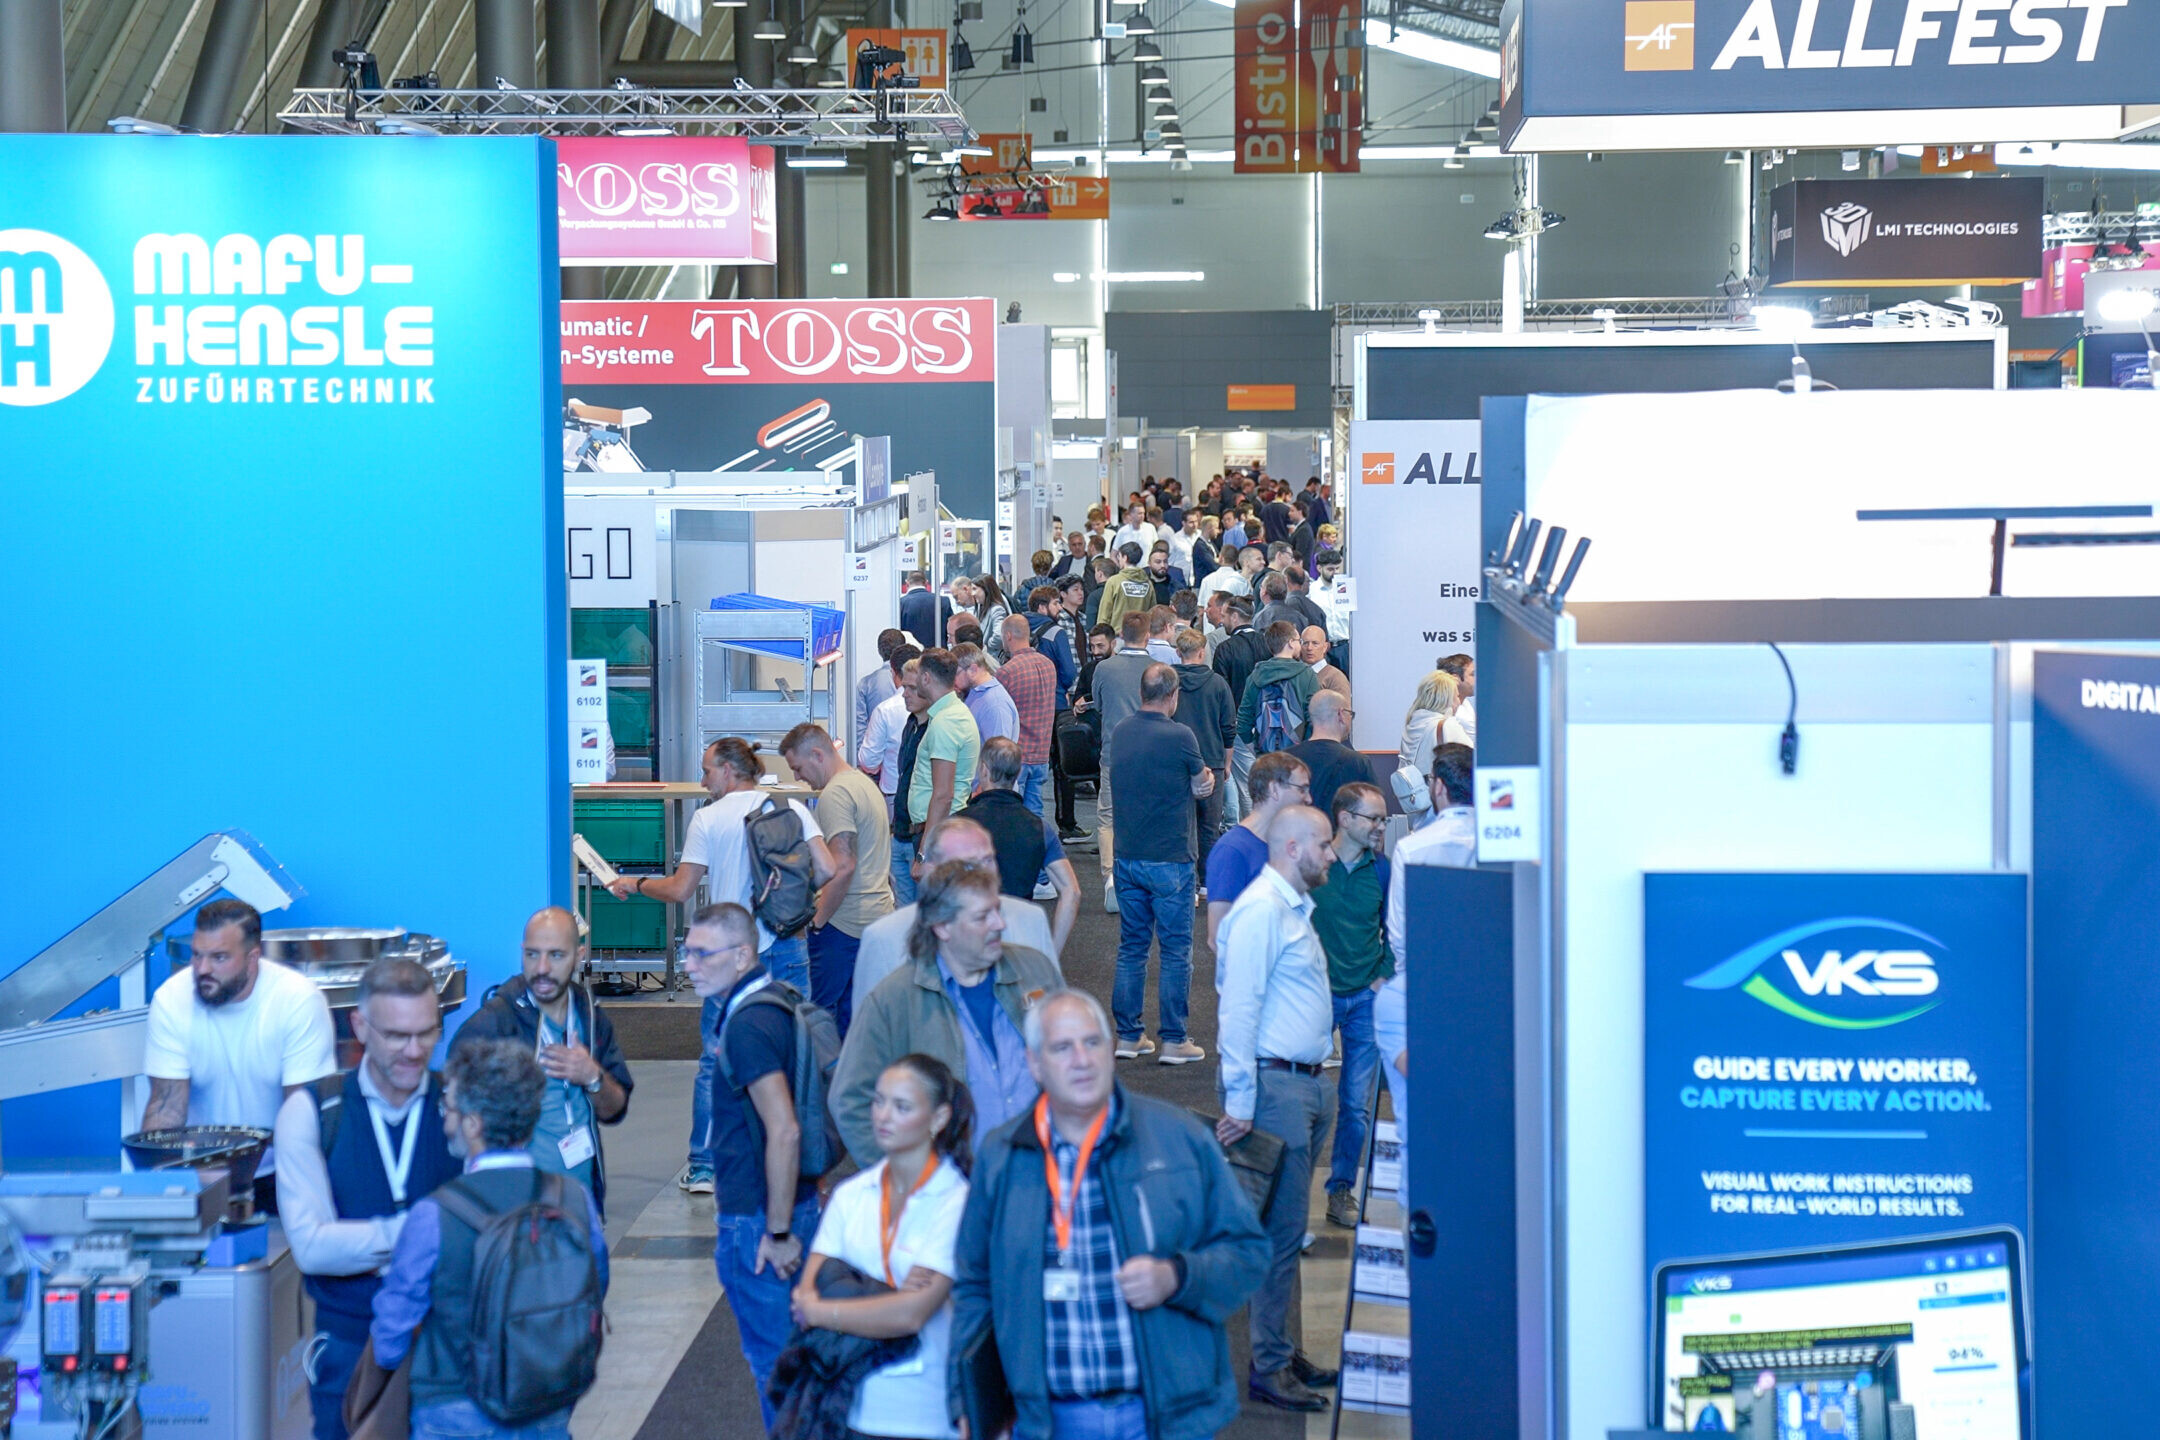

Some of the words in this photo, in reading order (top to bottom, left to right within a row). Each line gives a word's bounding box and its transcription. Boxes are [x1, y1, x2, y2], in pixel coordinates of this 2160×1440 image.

[1710, 0, 2128, 70] ALLFEST
[1244, 12, 1286, 165] Bistro
[687, 219, 695, 229] &
[1824, 202, 1869, 222] 3D
[1820, 211, 1873, 257] LMI
[1876, 224, 1901, 237] LMI
[1904, 223, 2019, 237] TECHNOLOGIES
[134, 304, 434, 366] HENSLE
[690, 307, 973, 376] TOSS
[136, 372, 436, 404] ZUFÜHRTECHNIK
[1440, 583, 1479, 598] Eine
[1423, 630, 1458, 642] was
[577, 697, 602, 707] 6102
[576, 759, 601, 768] 6101
[1484, 826, 1521, 839] 6204
[1781, 949, 1940, 996] VKS
[1693, 1056, 1771, 1081] GUIDE
[1774, 1057, 1855, 1082] EVERY
[1857, 1057, 1978, 1086] WORKER,
[1680, 1085, 1797, 1111] CAPTURE
[1800, 1087, 1880, 1111] EVERY
[1884, 1089, 1992, 1112] ACTION.
[1701, 1171, 1768, 1192] VISUAL
[1770, 1172, 1830, 1193] WORK
[1833, 1173, 1973, 1195] INSTRUCTIONS
[1711, 1193, 1748, 1213] FOR
[1752, 1194, 1877, 1216] REAL-WORLD
[1879, 1197, 1964, 1217] RESULTS.
